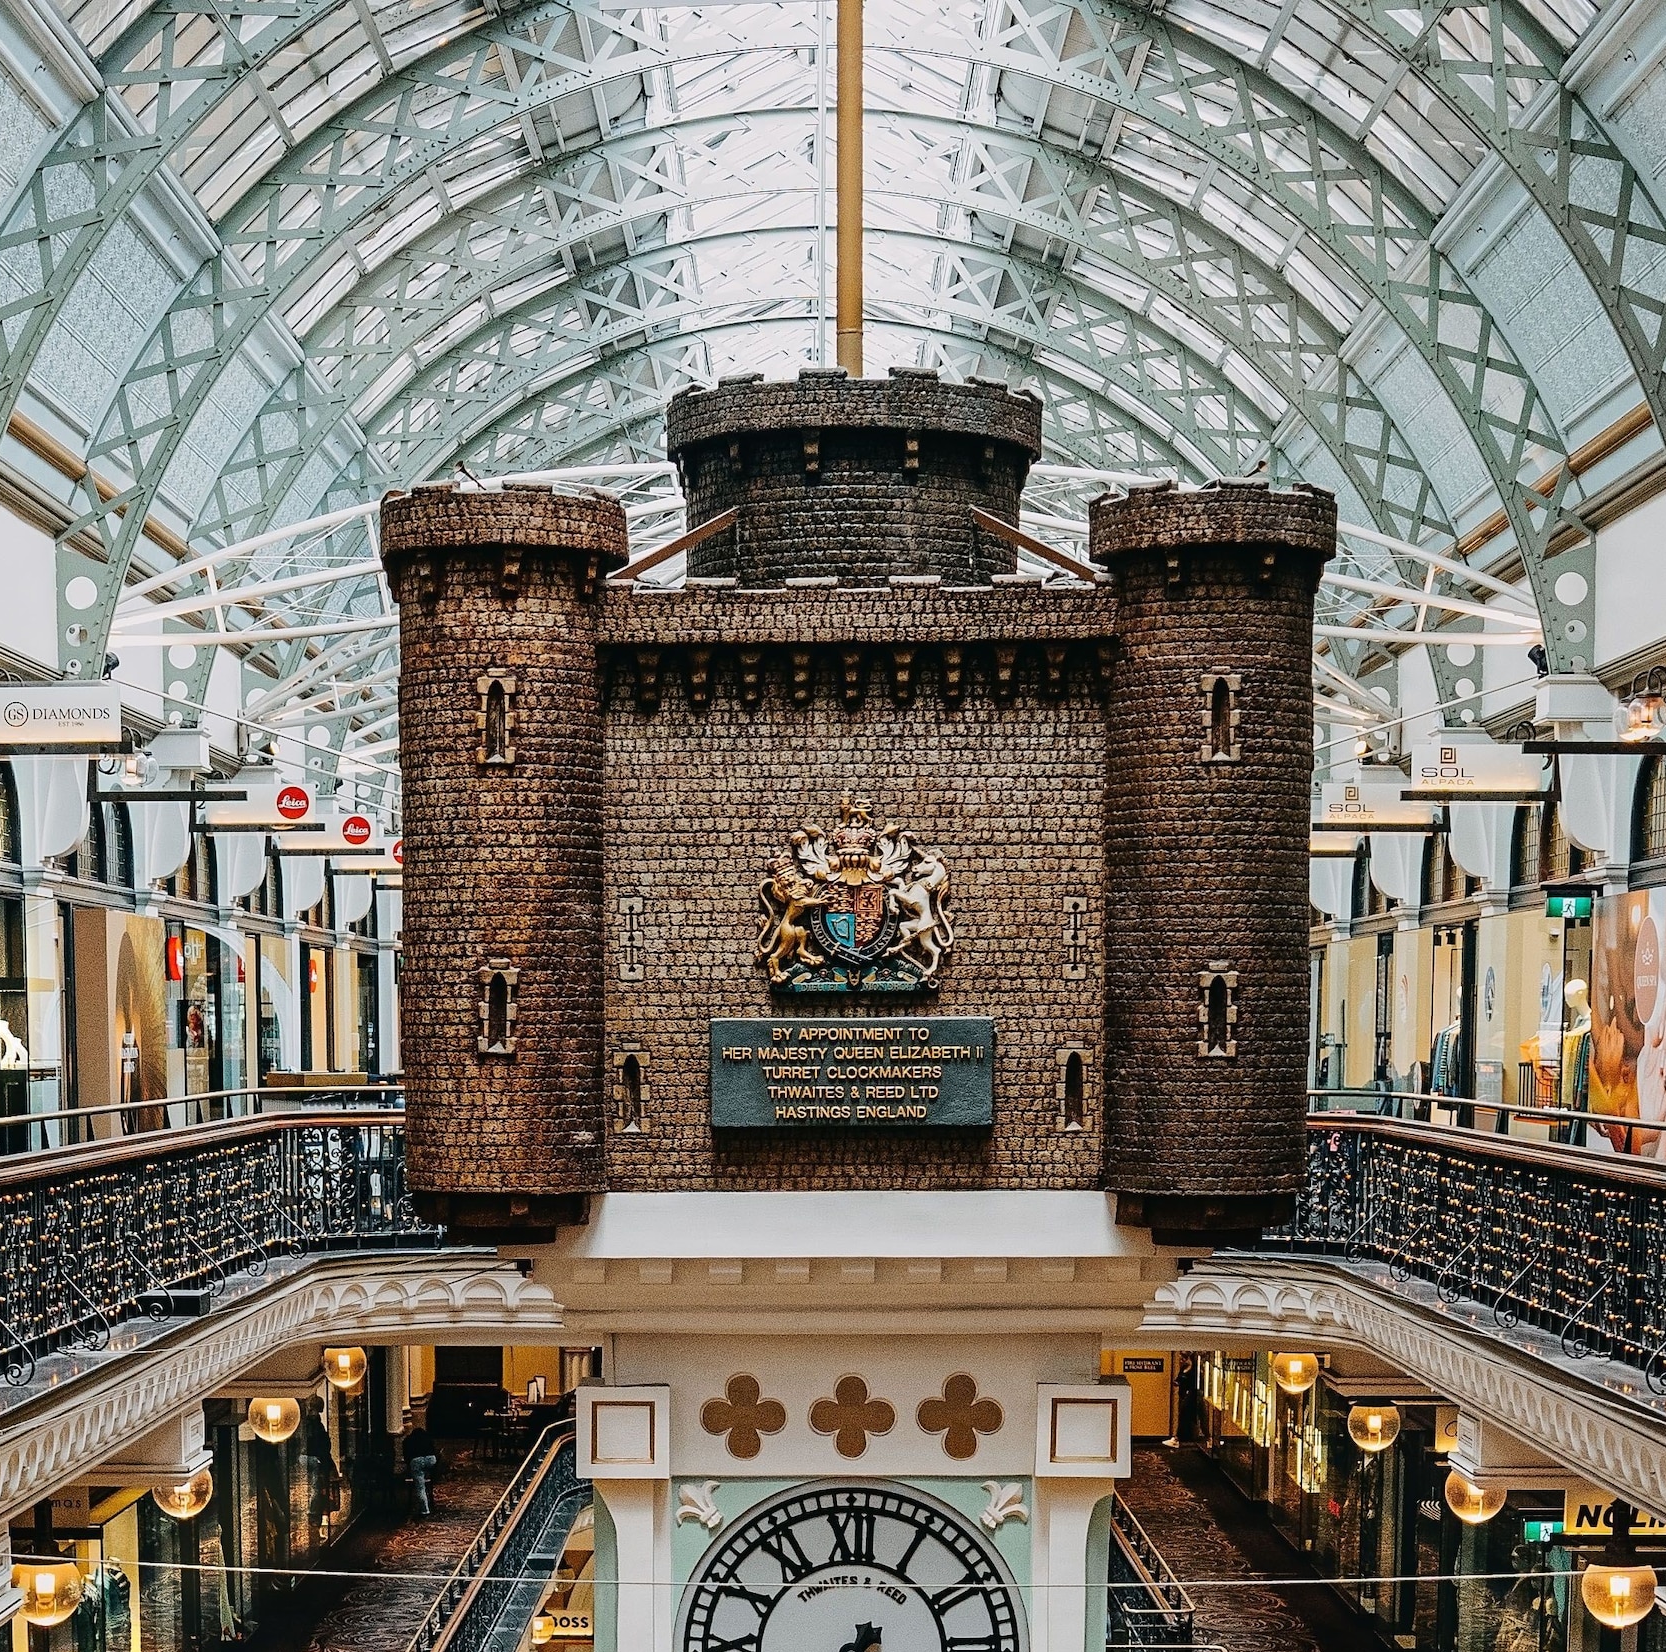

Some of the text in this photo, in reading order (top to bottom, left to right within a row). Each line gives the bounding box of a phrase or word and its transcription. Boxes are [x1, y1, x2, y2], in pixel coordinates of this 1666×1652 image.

[8, 706, 110, 720] GS DIAMONDS
[1421, 767, 1474, 778] SOL
[278, 795, 307, 809] Leica
[1329, 803, 1375, 813] SOL
[344, 823, 369, 836] Leica
[772, 1027, 929, 1041] BY APPOINTMENT TO
[722, 1047, 752, 1059] HER
[758, 1047, 827, 1060] MAJESTY
[833, 1047, 884, 1060] QUEEN
[889, 1046, 971, 1059] ELIZABETH
[762, 1066, 942, 1079] TURRET CLOCKMAKERS
[767, 1086, 939, 1099] THWAITES & REED LTD
[775, 1105, 927, 1119] HASTINGS ENGLAND
[828, 1511, 875, 1562] XII
[797, 1576, 908, 1605] THWAITES & REED
